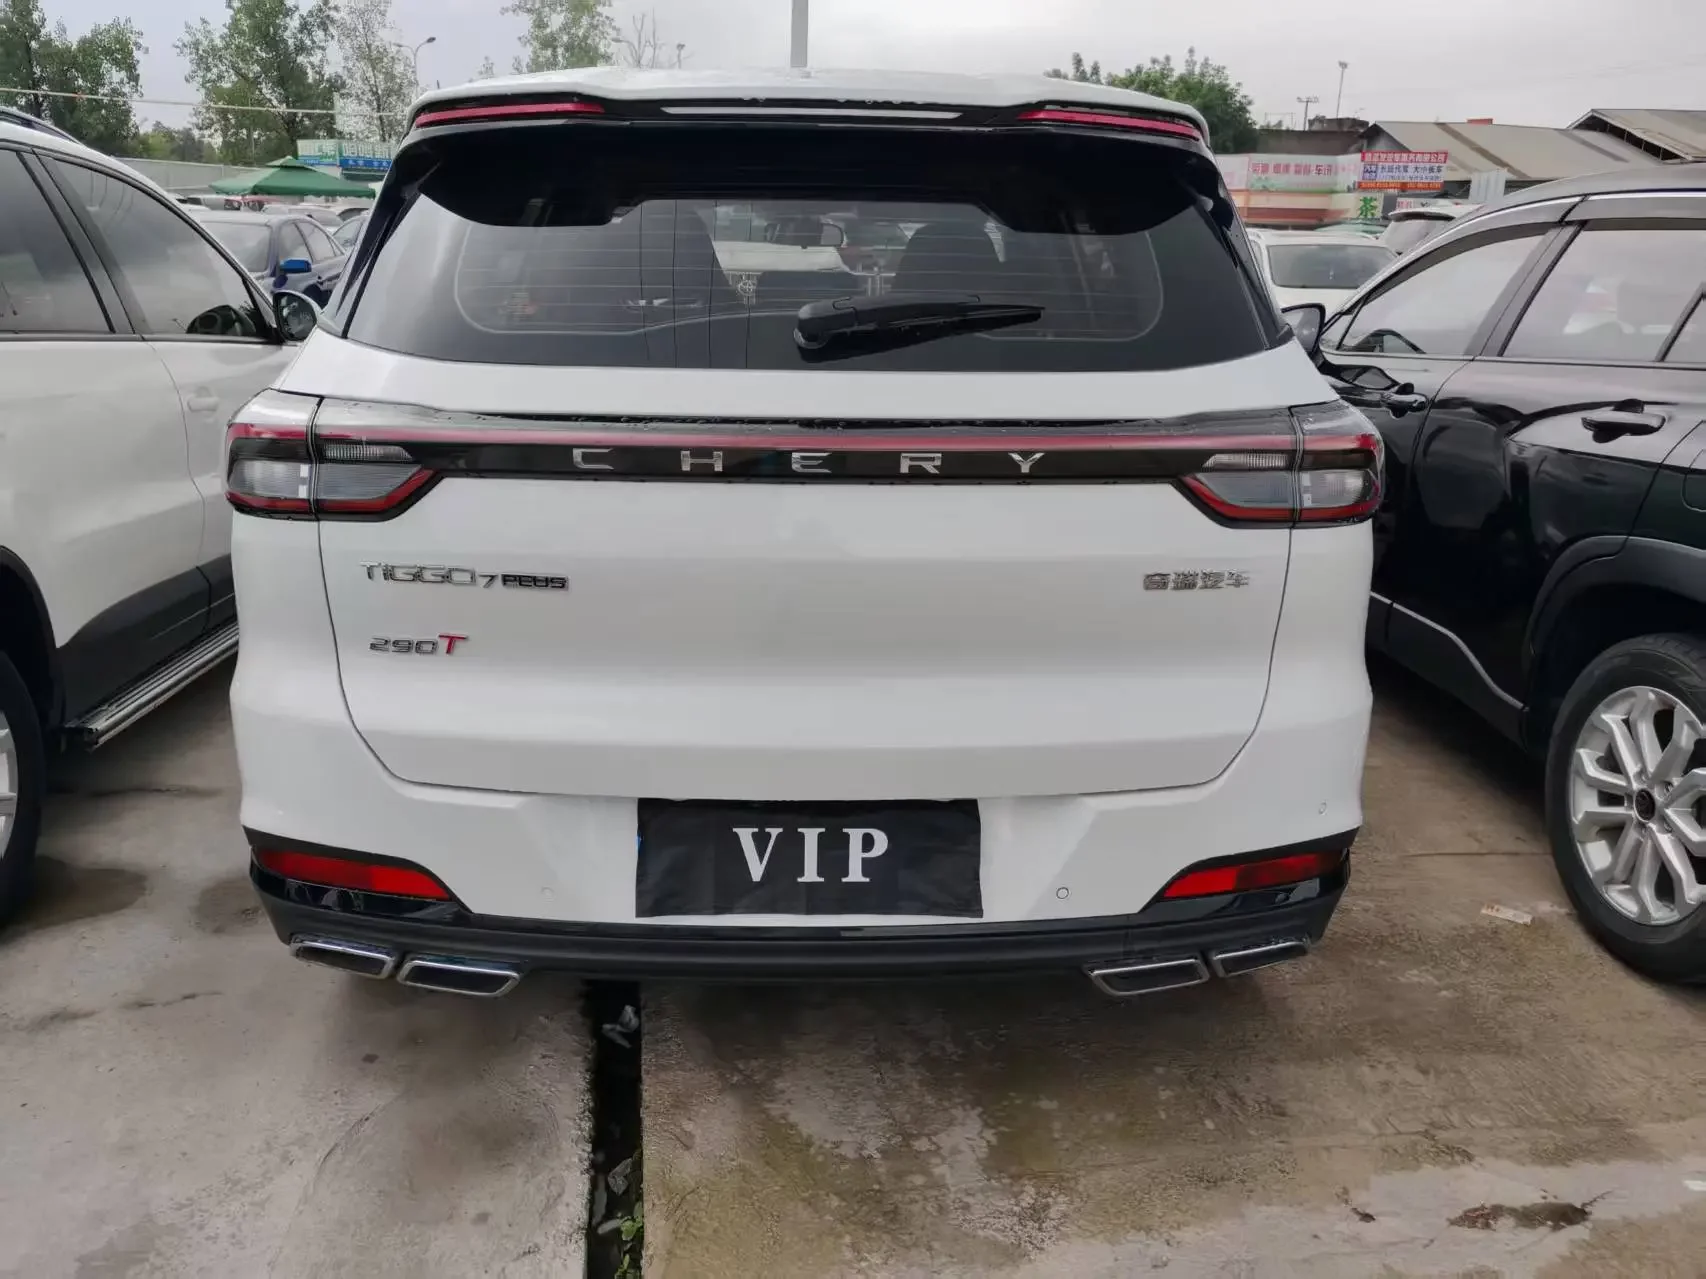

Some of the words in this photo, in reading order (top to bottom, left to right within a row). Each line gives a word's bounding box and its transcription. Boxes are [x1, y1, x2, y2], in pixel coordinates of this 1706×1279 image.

[1359, 197, 1377, 218] 茶
[573, 447, 1045, 474] CHERY
[369, 633, 469, 656] 290T
[732, 827, 889, 882] VIP
